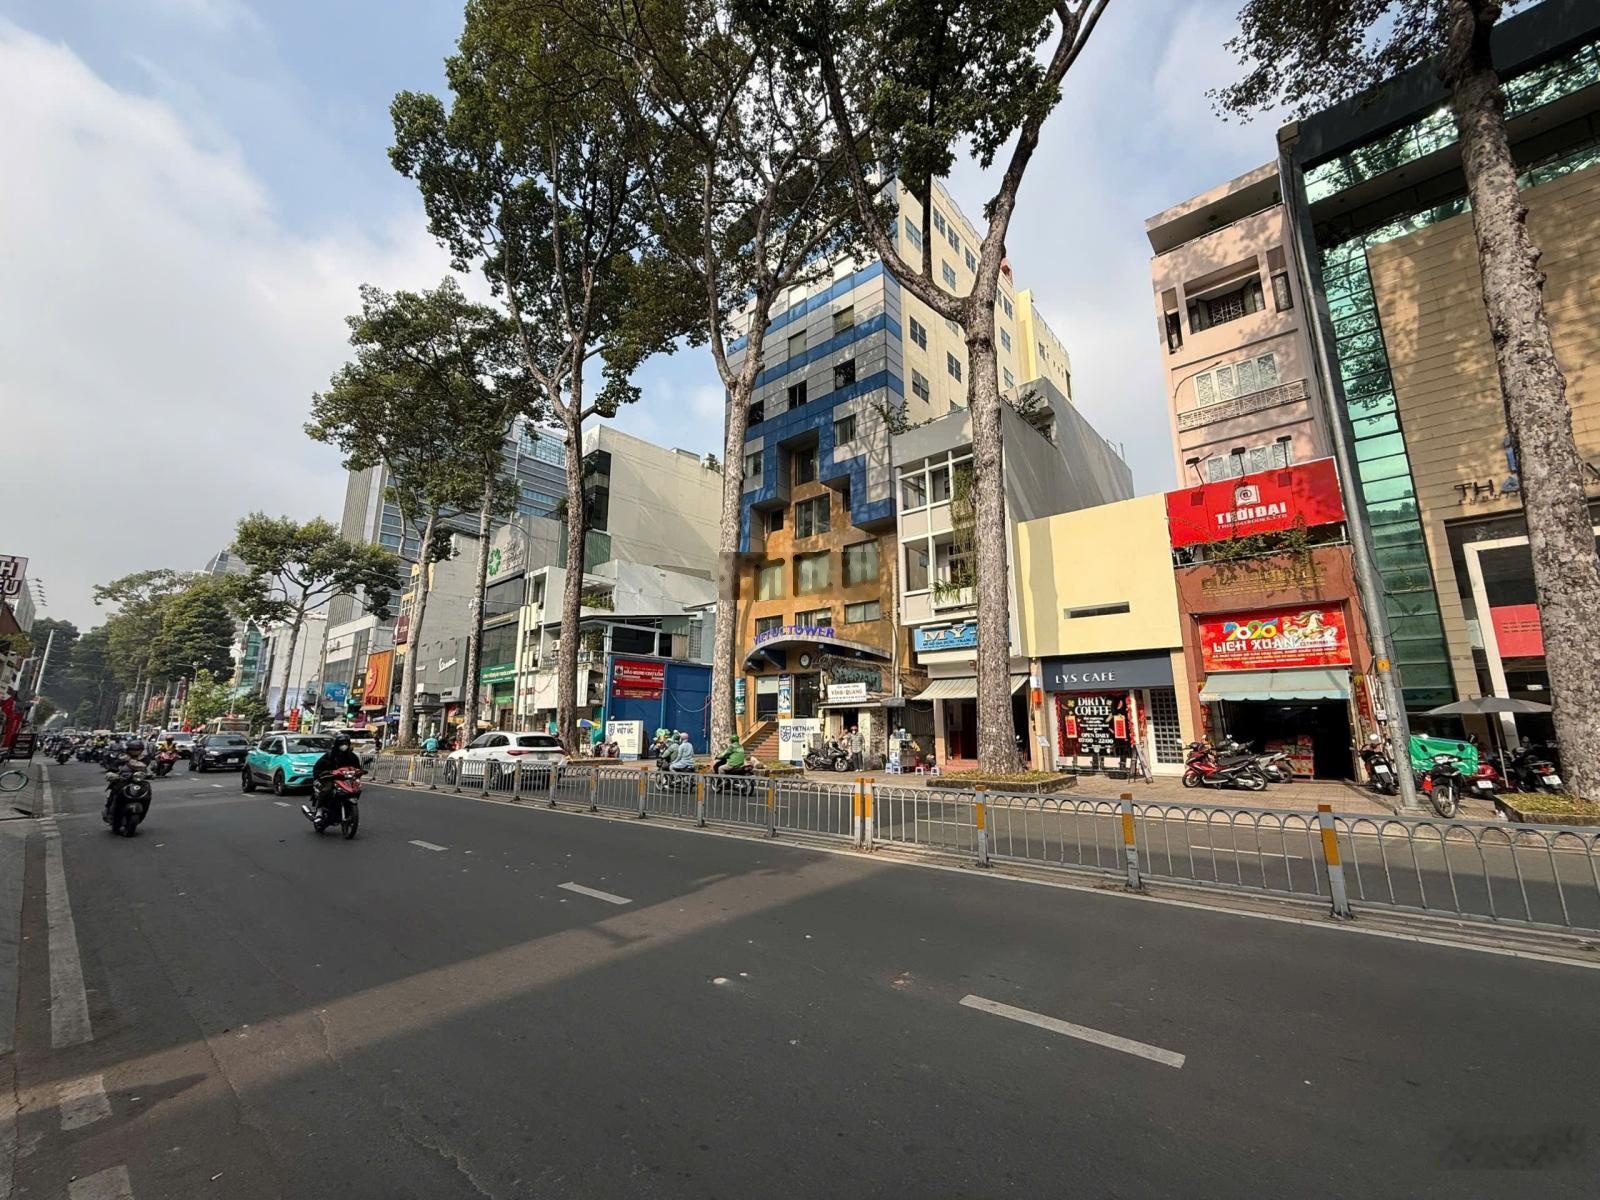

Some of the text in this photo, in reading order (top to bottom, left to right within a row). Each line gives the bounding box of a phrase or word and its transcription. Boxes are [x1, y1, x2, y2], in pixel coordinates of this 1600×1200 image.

[787, 625, 836, 639] TOWER
[1055, 671, 1116, 684] LYS CAFÉ
[1077, 696, 1108, 706] DIRTY
[1074, 705, 1112, 716] COFFEE
